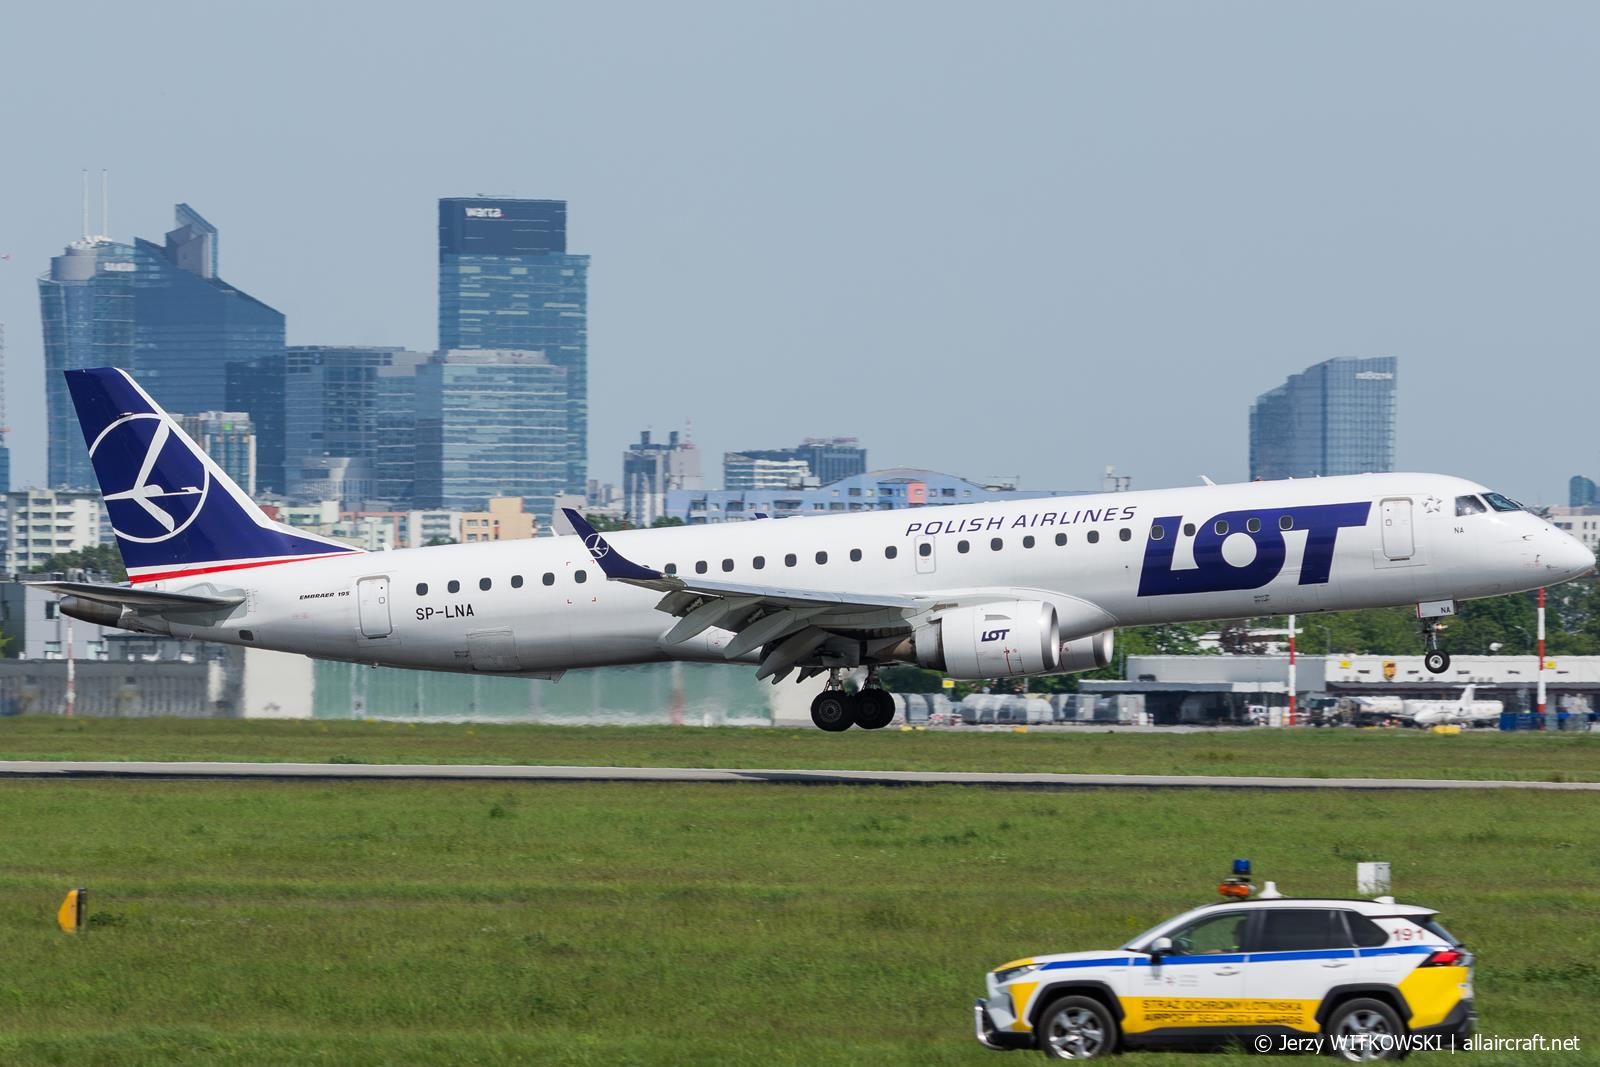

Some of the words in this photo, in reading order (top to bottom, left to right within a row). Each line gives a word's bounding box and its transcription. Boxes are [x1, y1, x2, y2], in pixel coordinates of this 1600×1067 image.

[905, 516, 1004, 536] POLISH
[1011, 506, 1137, 529] AIRLINES
[1137, 501, 1372, 597] LOT
[299, 592, 335, 600] EMBRAER
[415, 603, 475, 620] SP-LNA
[981, 629, 1011, 642] LOT
[1392, 928, 1425, 941] 191
